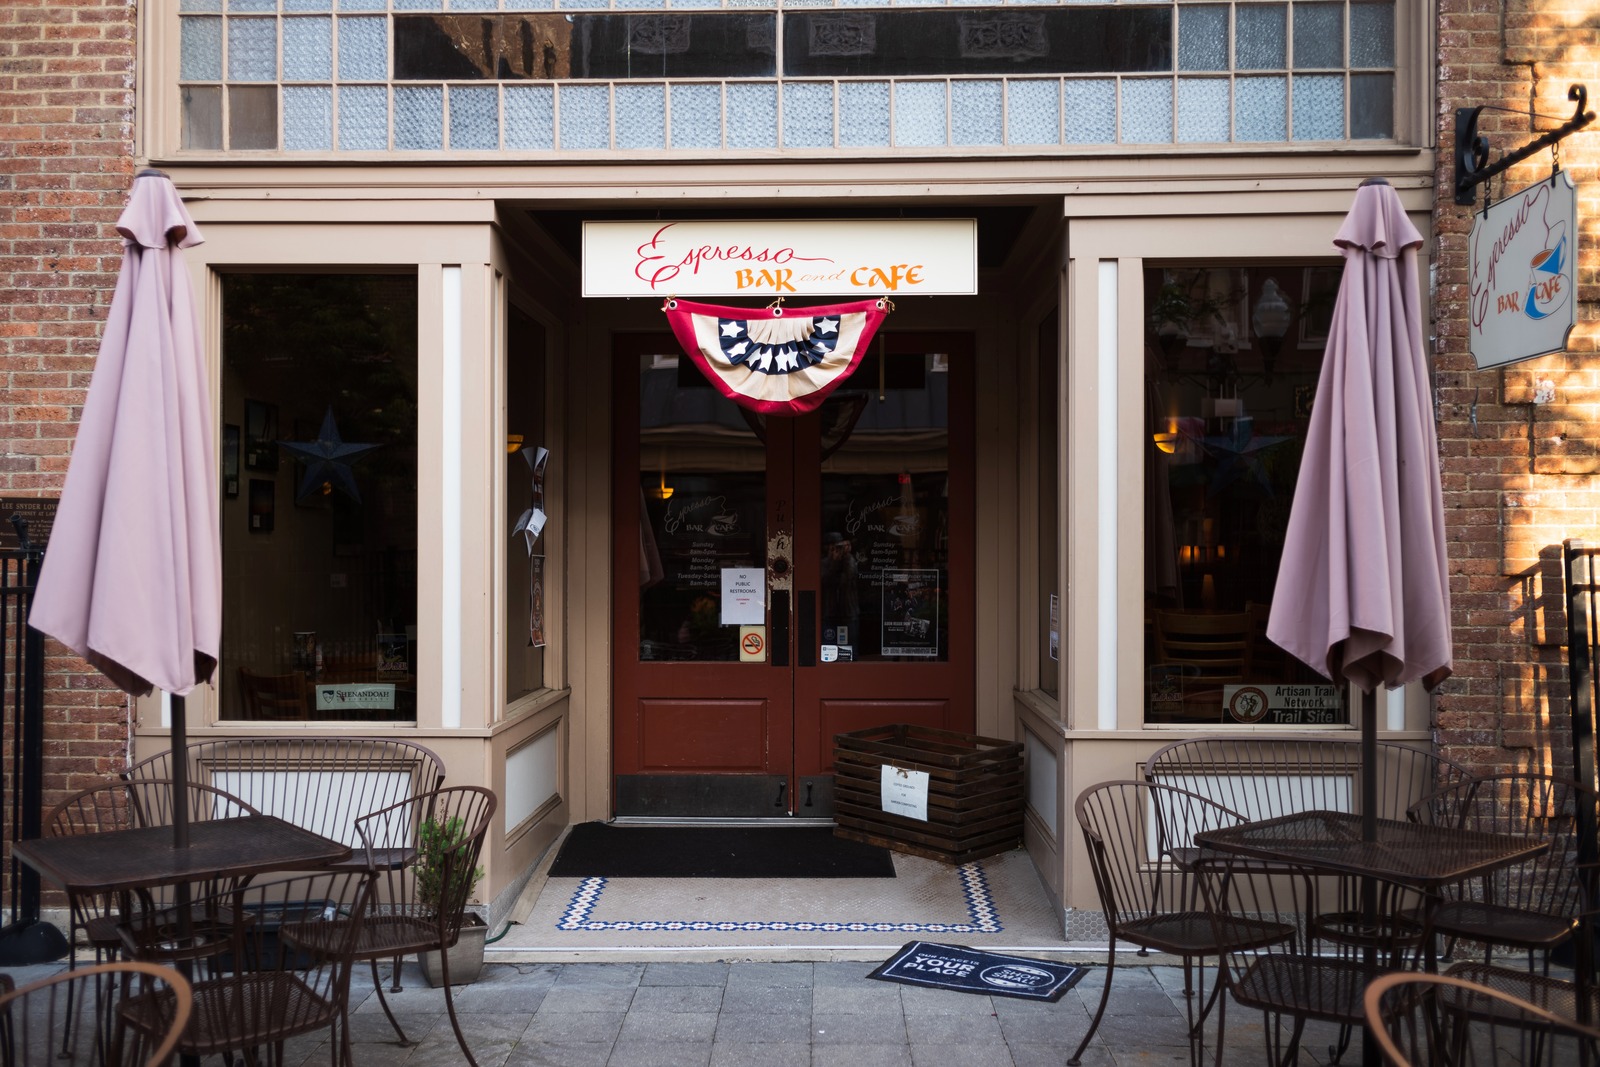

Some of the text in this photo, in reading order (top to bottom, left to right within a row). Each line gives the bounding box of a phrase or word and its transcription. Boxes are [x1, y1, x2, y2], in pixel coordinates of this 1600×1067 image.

[635, 222, 834, 290] Espresso
[1471, 188, 1539, 336] Espresso
[735, 264, 925, 293] BAR and CAFE
[1497, 274, 1562, 315] BAR CAFE
[1, 502, 14, 510] LEE
[692, 541, 714, 549] Sunday
[873, 541, 896, 549] Sunday
[1275, 686, 1335, 697] Artisan Trail
[1284, 697, 1325, 708] Network
[1273, 710, 1334, 723] Trail Site
[914, 956, 976, 972] YOUR
[939, 956, 970, 964] PLACE
[903, 962, 971, 978] PLACE
[1001, 969, 1041, 980] SHOP
[991, 972, 1036, 985] SMALL
